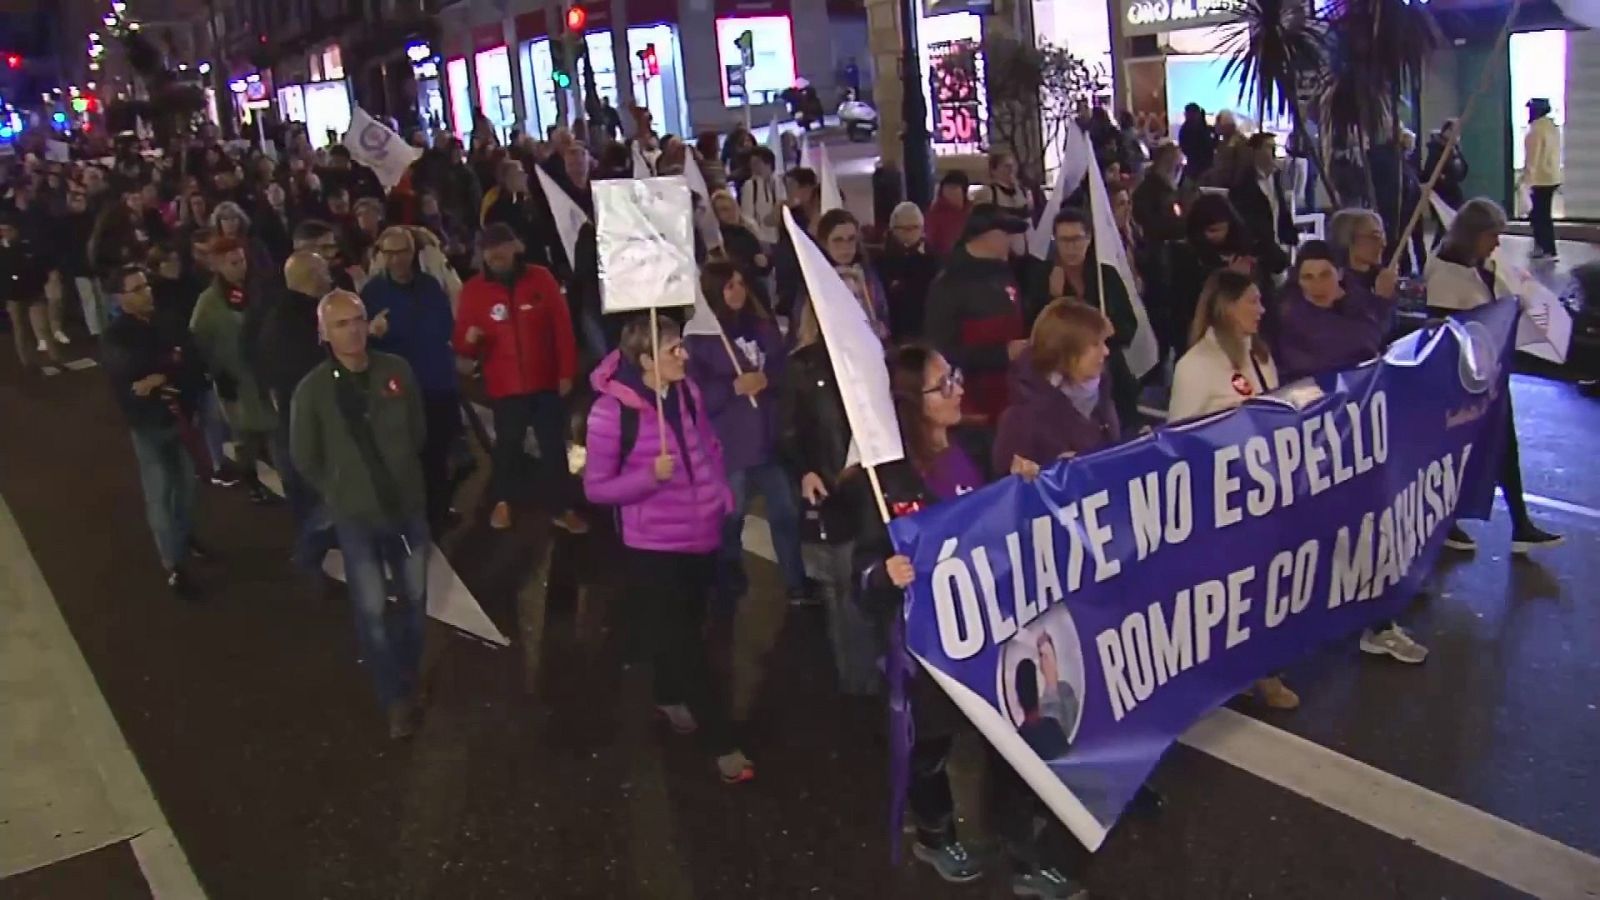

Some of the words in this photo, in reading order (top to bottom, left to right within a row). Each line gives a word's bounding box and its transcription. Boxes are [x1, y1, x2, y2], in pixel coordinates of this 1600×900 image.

[931, 489, 1121, 660] ÓLLATE
[1128, 460, 1193, 561] NO
[1214, 390, 1388, 528] ESPELLO
[1096, 566, 1256, 722] ROMPE
[1265, 539, 1319, 628] CO
